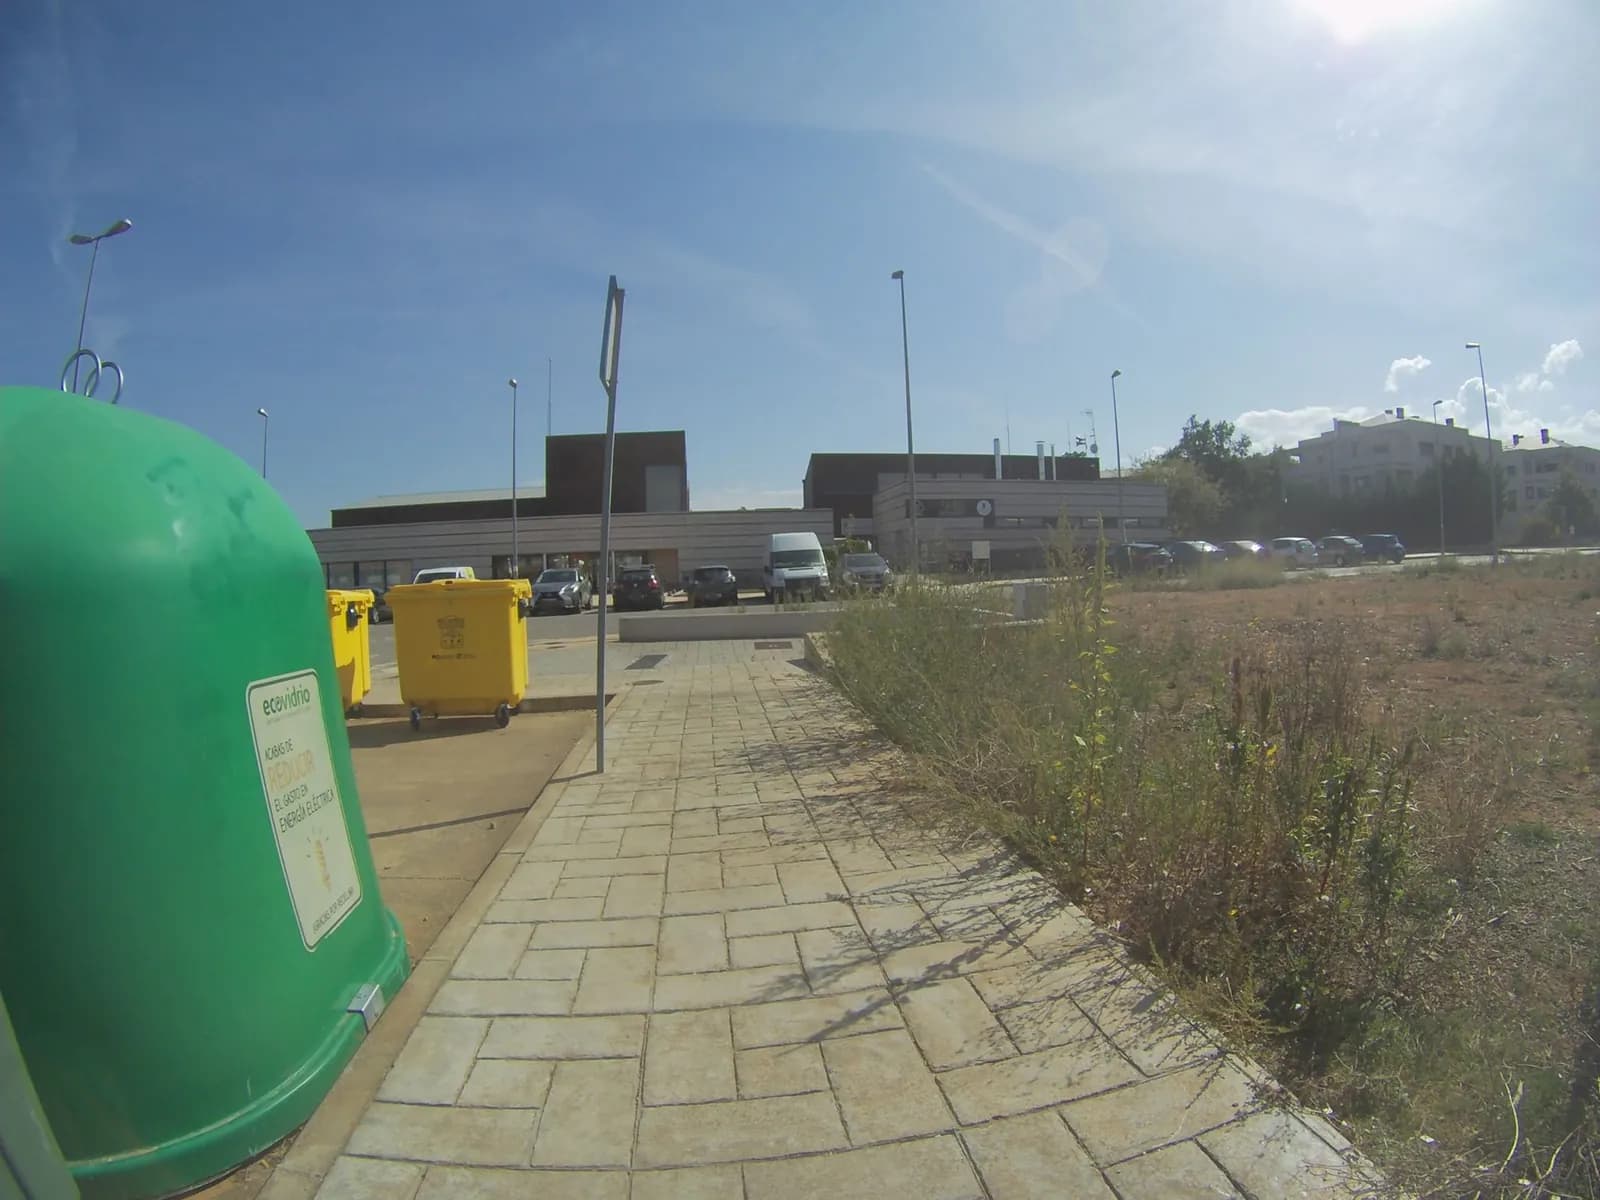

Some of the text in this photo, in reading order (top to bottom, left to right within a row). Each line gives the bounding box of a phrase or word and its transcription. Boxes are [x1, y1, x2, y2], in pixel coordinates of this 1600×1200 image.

[262, 684, 310, 716] ecovidrio
[265, 738, 294, 761] ACABAS DE
[274, 784, 308, 813] EL GASTO EN
[280, 804, 306, 833] ENERGÍA
